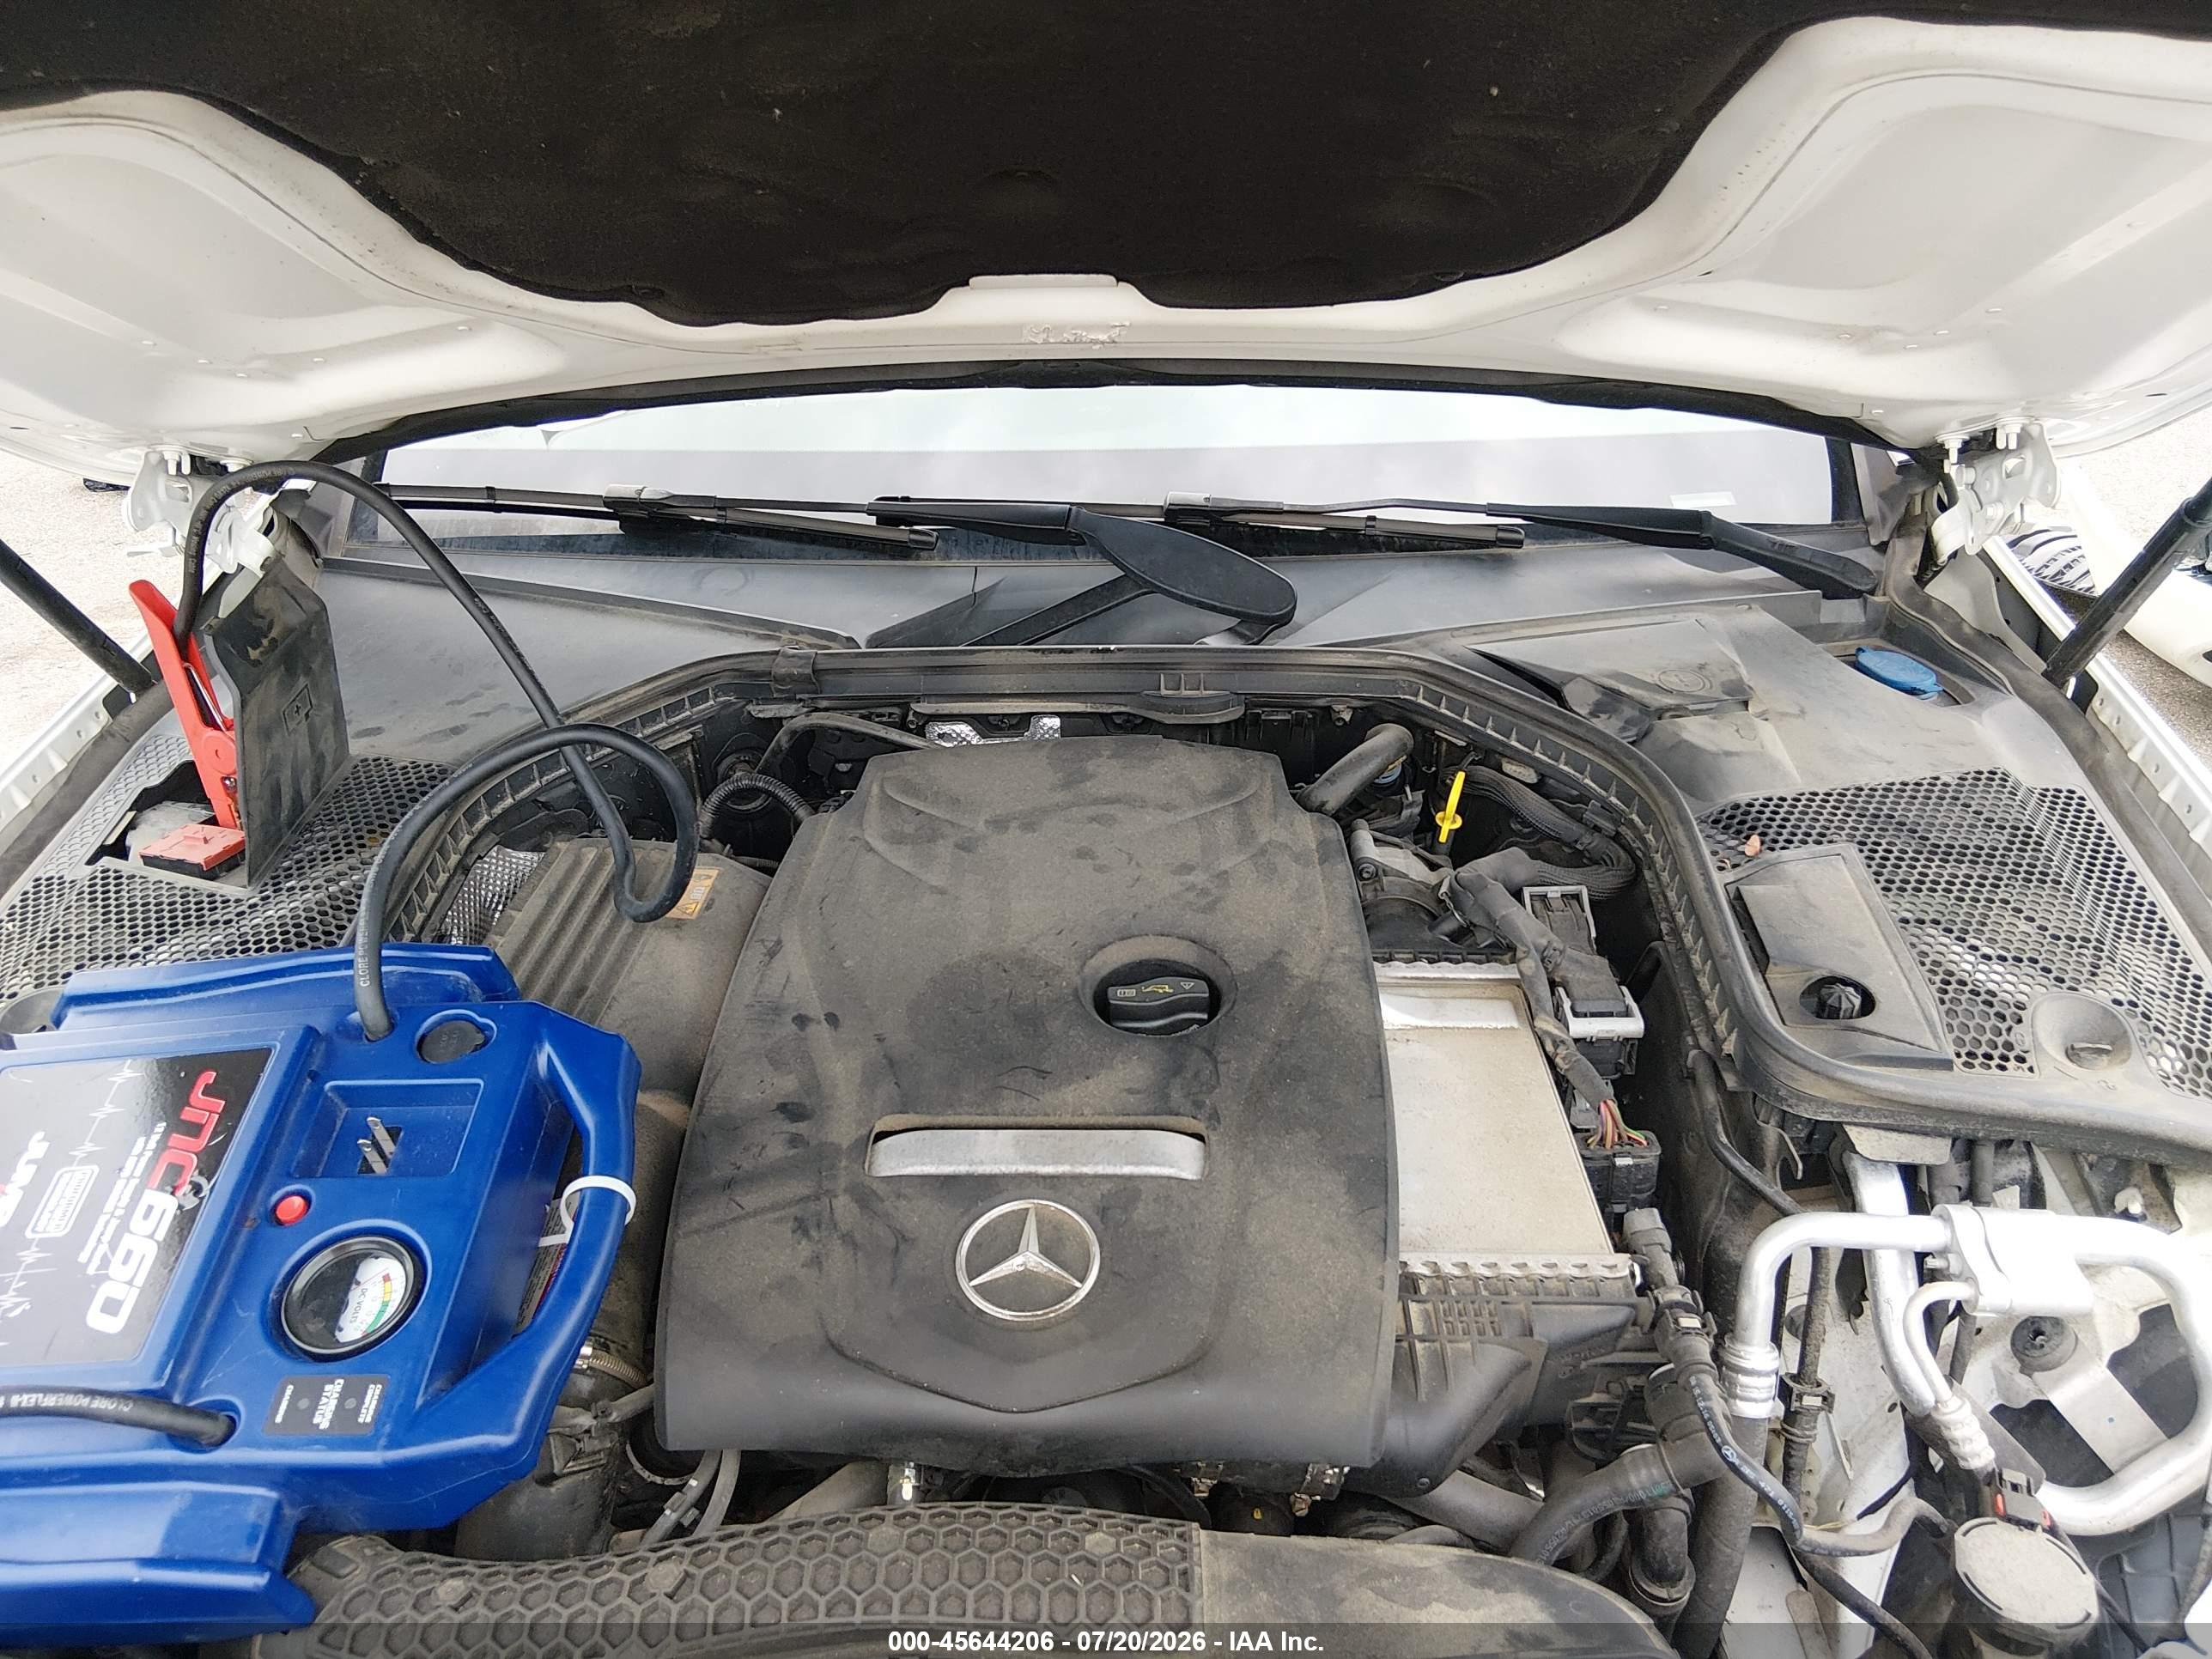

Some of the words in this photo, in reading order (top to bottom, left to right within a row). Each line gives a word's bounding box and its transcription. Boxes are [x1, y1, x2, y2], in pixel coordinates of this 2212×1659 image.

[358, 956, 370, 987] CLORE
[86, 1071, 226, 1334] JNC660
[360, 1288, 368, 1299] DC
[349, 1301, 364, 1323] VOLTS
[89, 1393, 134, 1411] CLORE
[313, 1384, 334, 1424] STATUS
